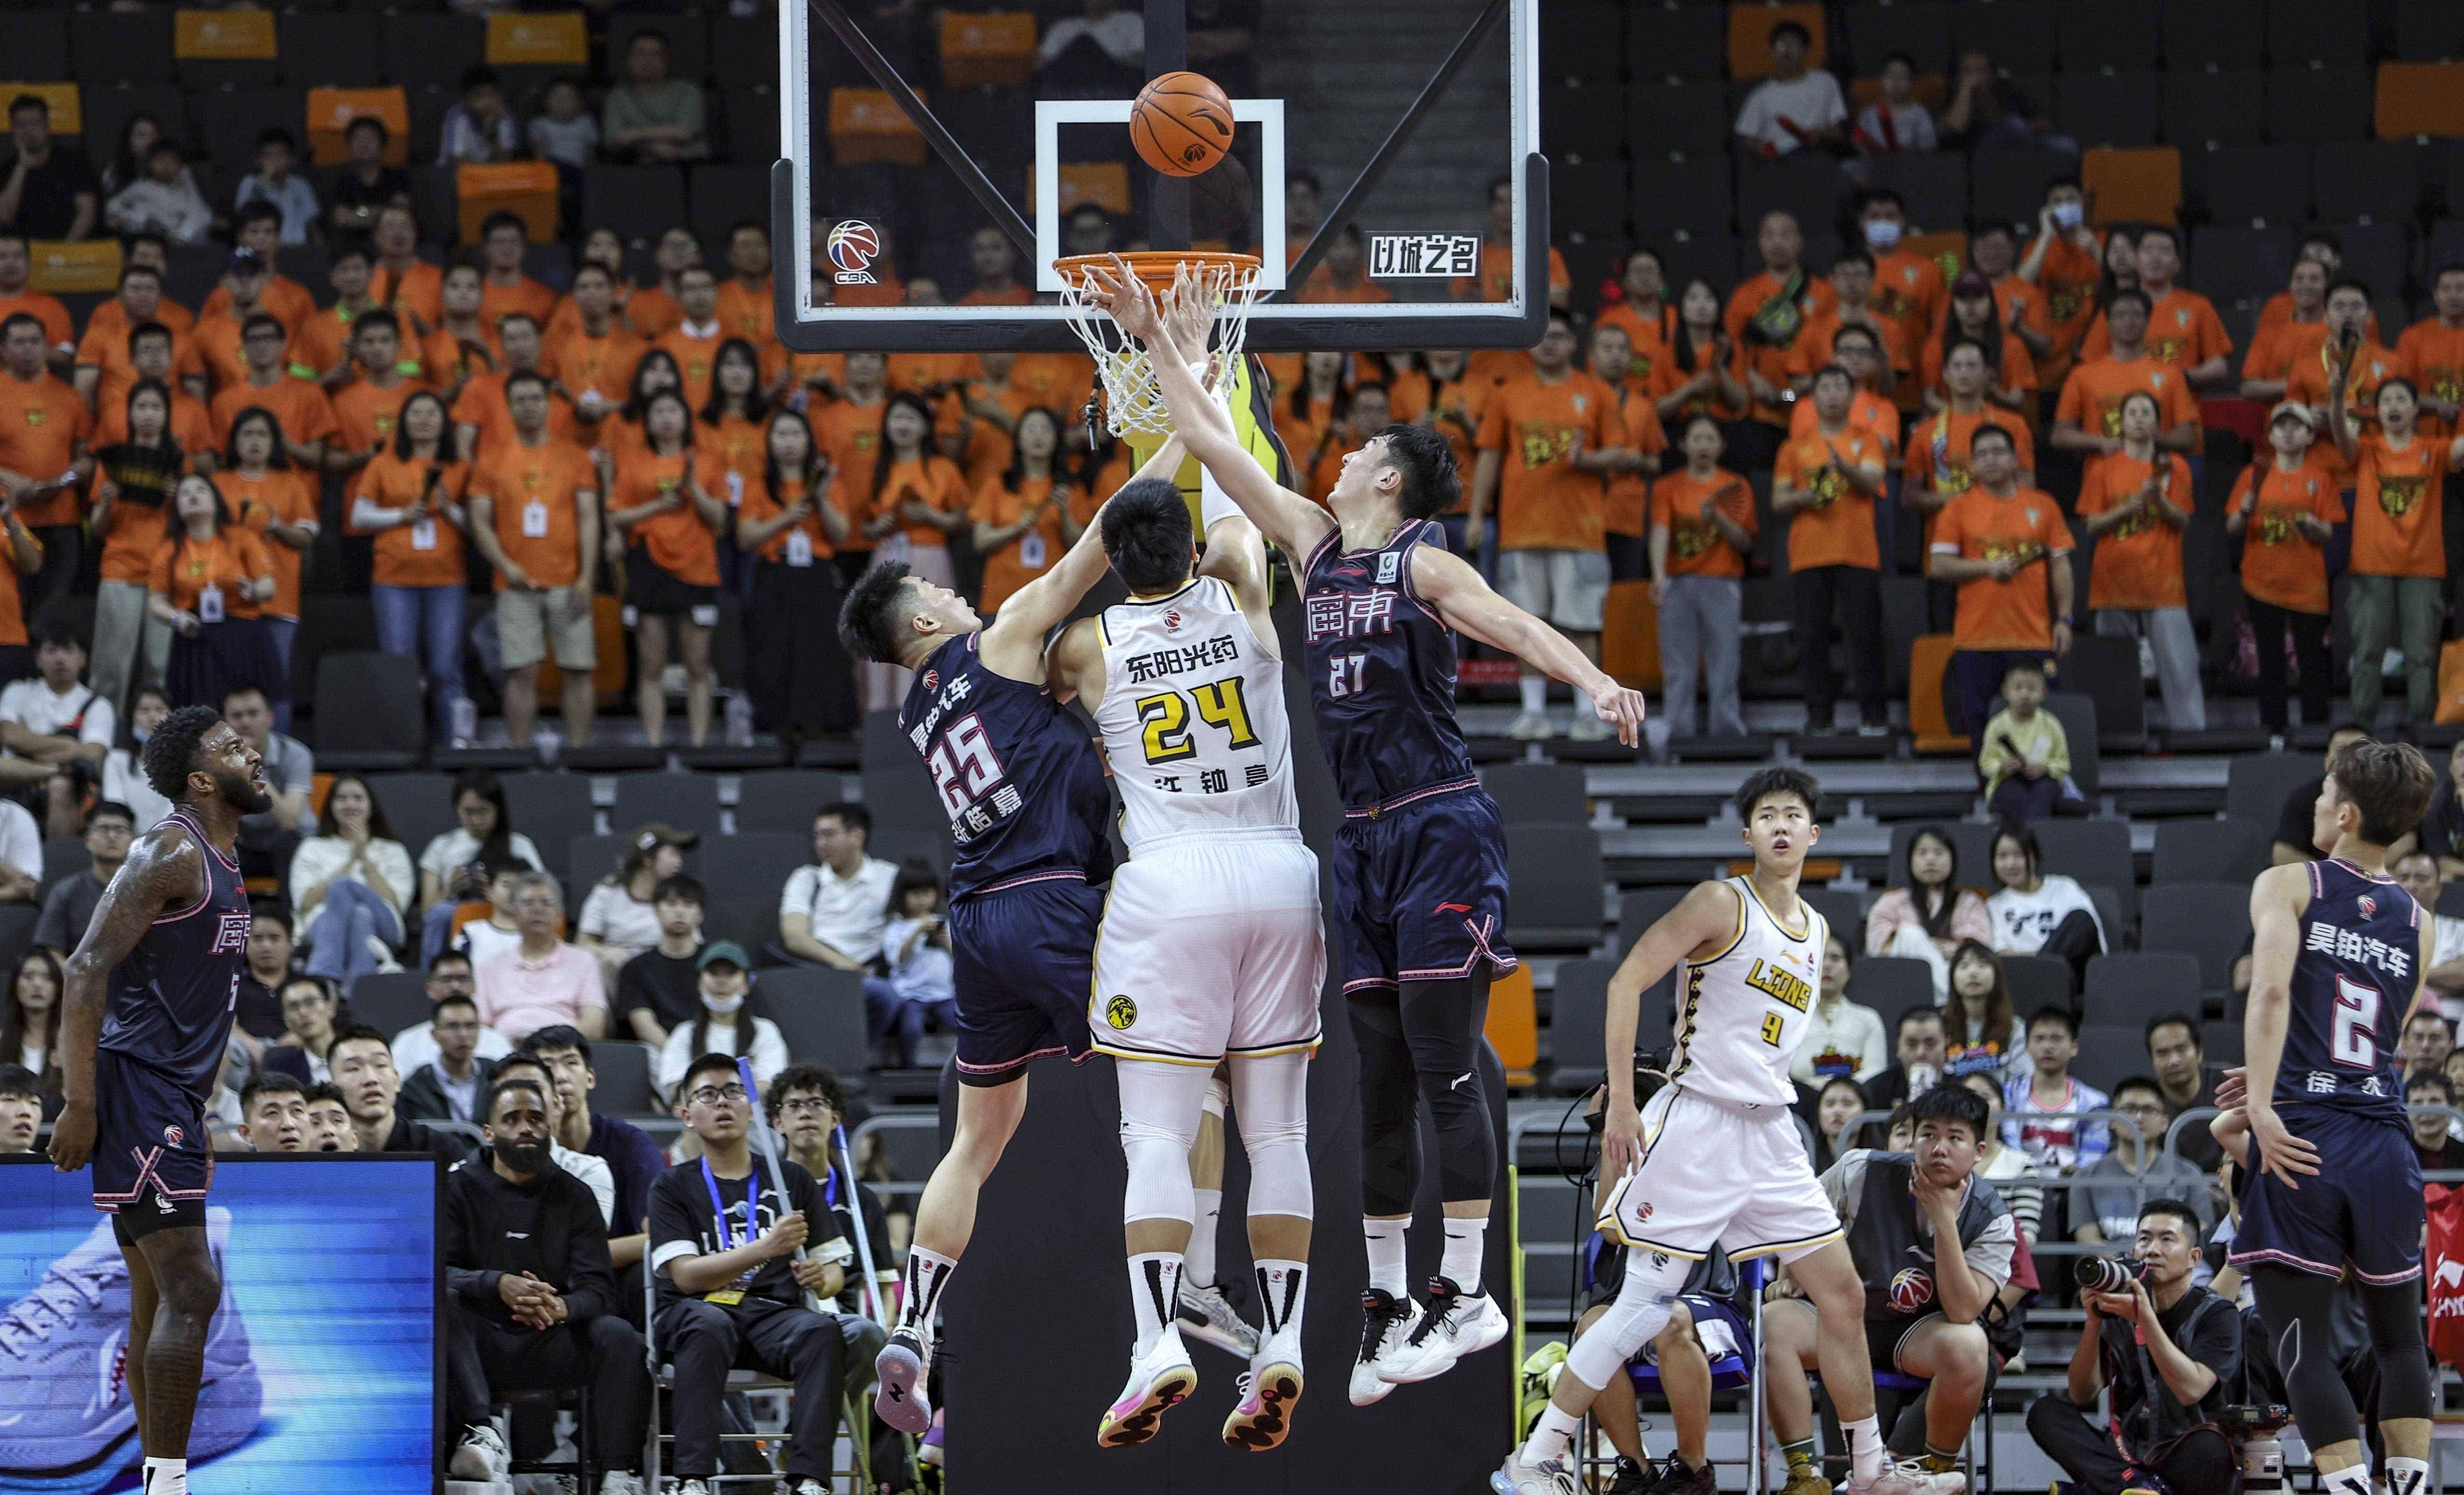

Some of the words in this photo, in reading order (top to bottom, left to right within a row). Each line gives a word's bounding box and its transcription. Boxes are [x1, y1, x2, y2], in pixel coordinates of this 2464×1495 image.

[835, 271, 877, 284] CBA
[1372, 237, 1475, 275] 以城之名
[1126, 634, 1239, 684] 东阳光药
[1329, 653, 1366, 699] 27
[1136, 675, 1263, 766] 24
[924, 712, 1006, 821] 25
[2305, 921, 2411, 978] 昊铂汽车
[1745, 958, 1812, 1014] LIONS
[1760, 1011, 1783, 1049] 9
[2330, 973, 2382, 1071] 2
